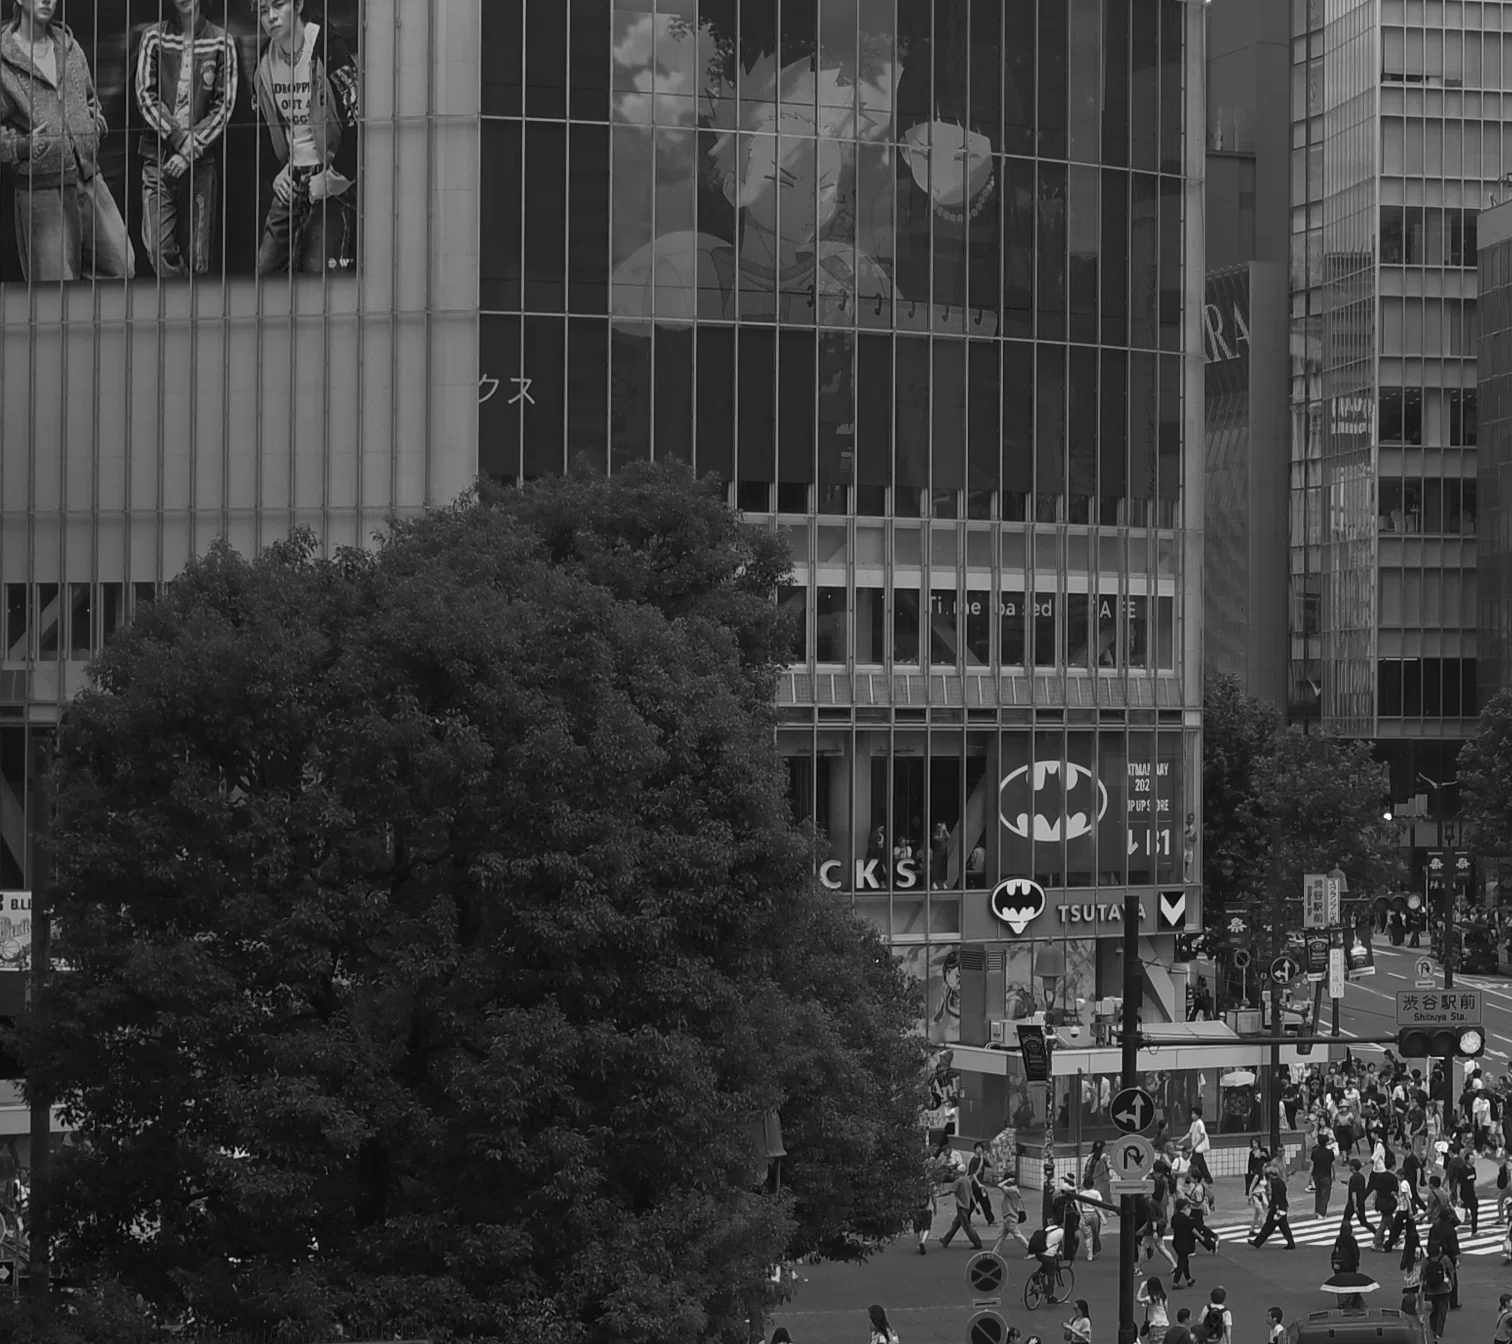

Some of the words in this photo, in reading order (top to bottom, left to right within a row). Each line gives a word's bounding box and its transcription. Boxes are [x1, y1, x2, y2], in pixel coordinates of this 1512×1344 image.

[819, 858, 918, 892] CKS
[1059, 904, 1148, 924] TSUTAA
[1403, 994, 1476, 1011] 渋谷駅前
[1414, 1012, 1447, 1023] Shibuya
